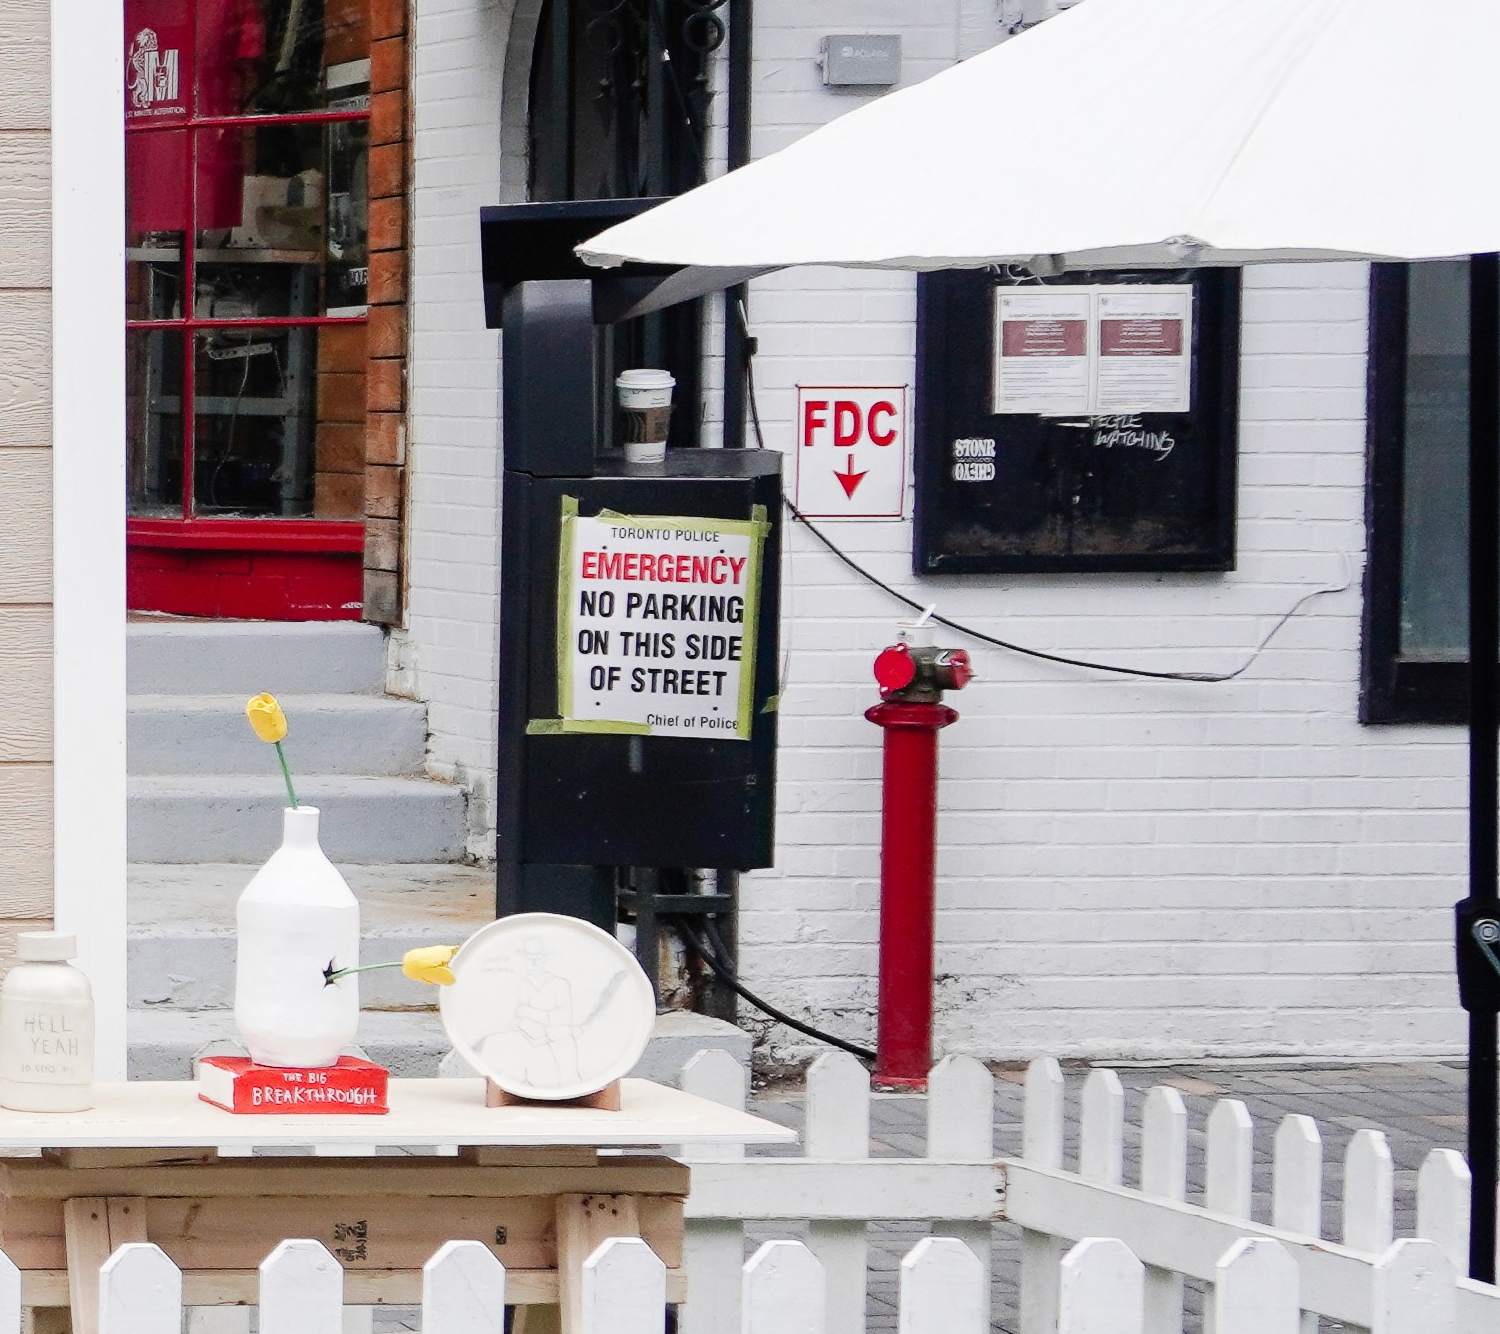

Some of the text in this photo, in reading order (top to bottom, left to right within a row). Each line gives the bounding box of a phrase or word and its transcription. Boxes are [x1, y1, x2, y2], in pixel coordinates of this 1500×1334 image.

[804, 400, 898, 447] FDC
[612, 527, 720, 543] TORONTO POLICE
[582, 552, 747, 584] EMERGENCY
[580, 591, 744, 623] NO PARKING
[578, 630, 743, 661] ON THIS SIDE
[590, 666, 728, 696] OF STREET
[647, 714, 738, 730] Chief of Police
[24, 1015, 73, 1033] HELL
[31, 1037, 78, 1055] YEAH
[283, 1072, 327, 1084] THE BIG
[252, 1087, 377, 1106] BREAKTHROUGH
